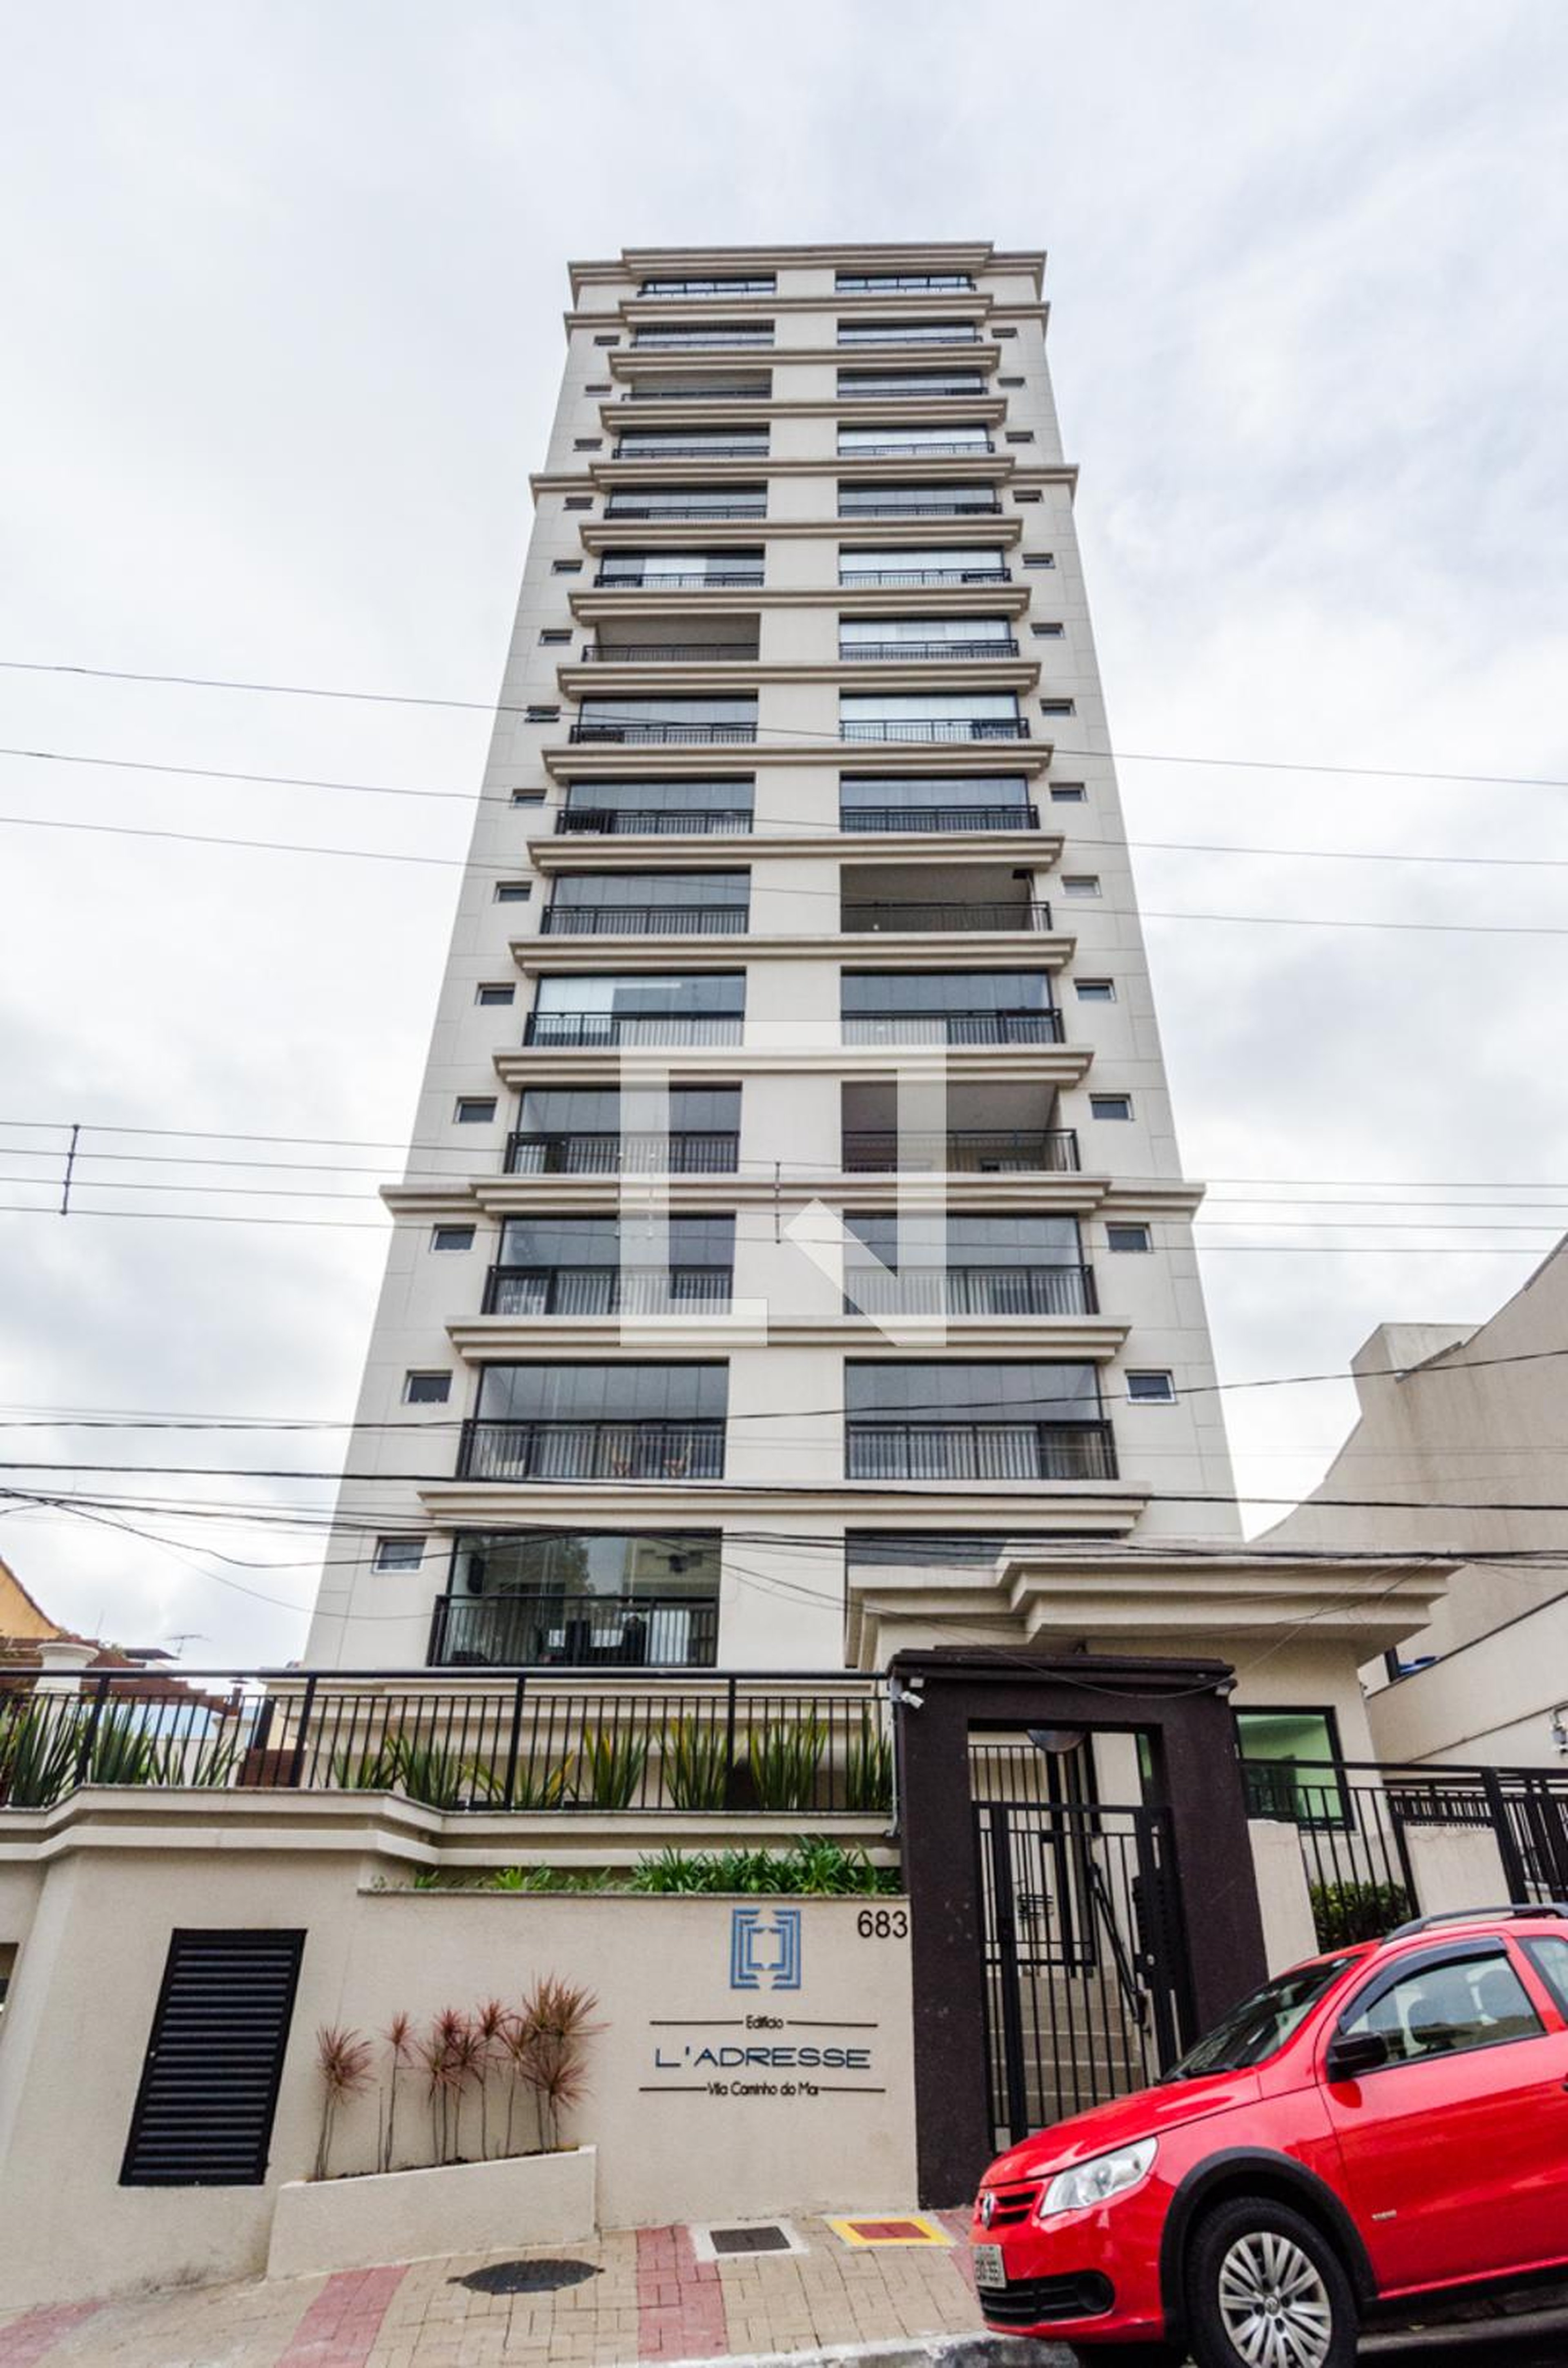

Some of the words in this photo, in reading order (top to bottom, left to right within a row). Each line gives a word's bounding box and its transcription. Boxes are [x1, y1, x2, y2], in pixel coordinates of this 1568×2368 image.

[858, 1910, 908, 1938] 683
[655, 2046, 871, 2069] L'ADRESSE
[780, 2080, 796, 2096] do
